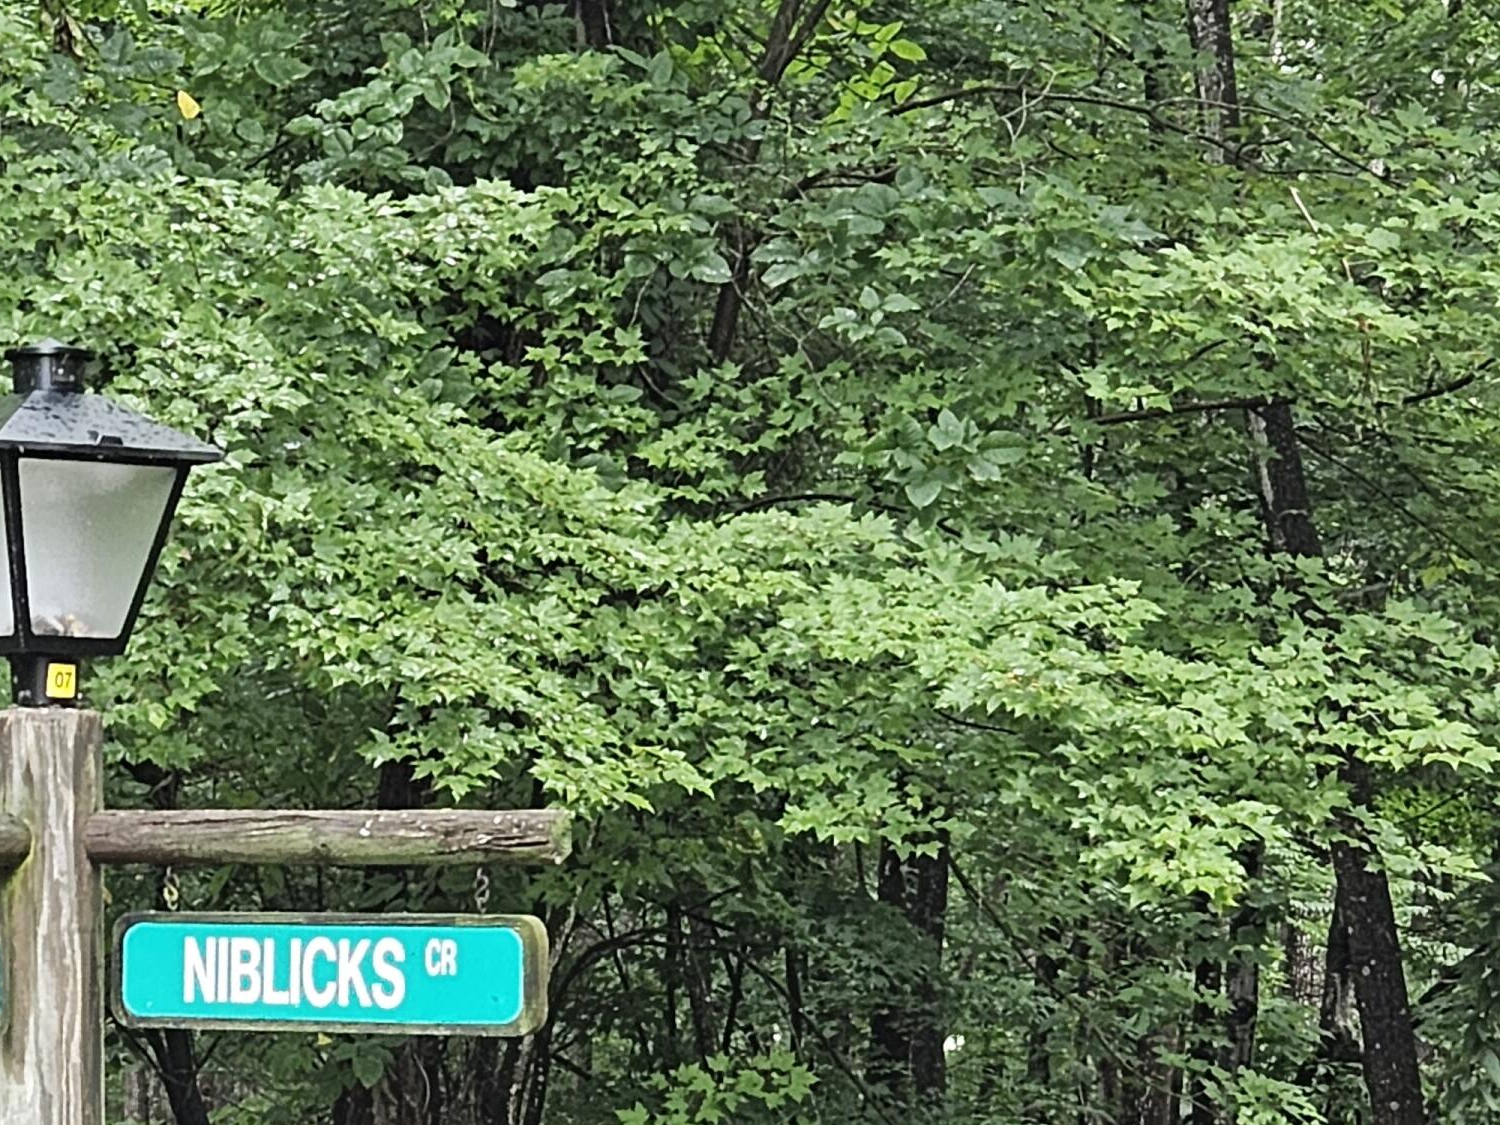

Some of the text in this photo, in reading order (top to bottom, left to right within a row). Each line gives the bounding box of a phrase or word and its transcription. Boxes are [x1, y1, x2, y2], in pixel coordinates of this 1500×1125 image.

[55, 671, 72, 688] 07
[183, 935, 458, 1010] NIBLICKS CR
